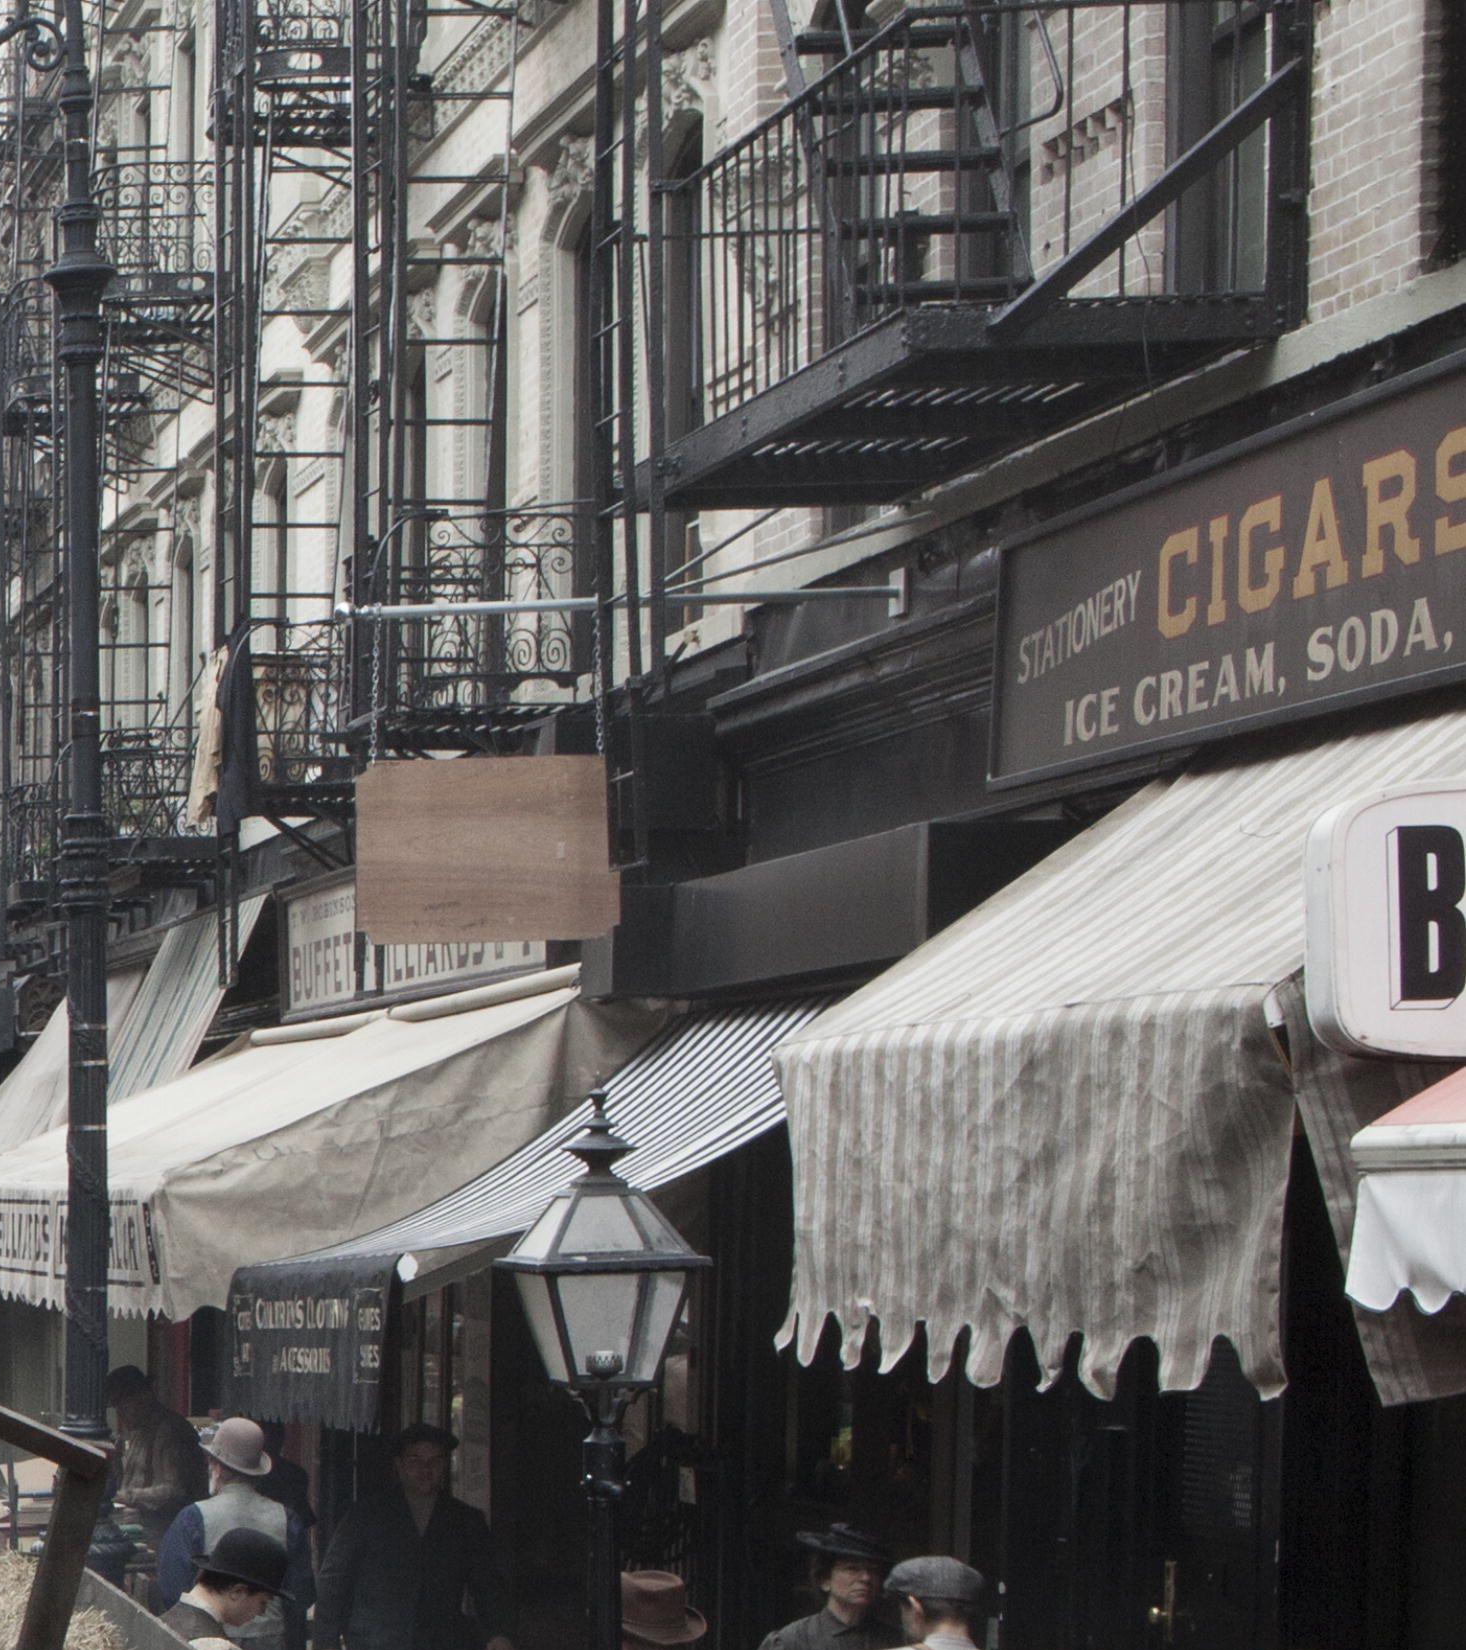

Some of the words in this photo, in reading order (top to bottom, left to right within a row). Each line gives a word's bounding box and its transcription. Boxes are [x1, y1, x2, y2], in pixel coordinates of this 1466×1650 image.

[1157, 426, 1466, 640] CIGARS
[1017, 570, 1142, 685] STATIONERY
[1063, 687, 1120, 746] ICE
[1133, 641, 1286, 727] CREAM,
[1306, 596, 1453, 682] SODA,
[292, 930, 353, 1003] BUFFET
[385, 941, 485, 985] ILLIARDS
